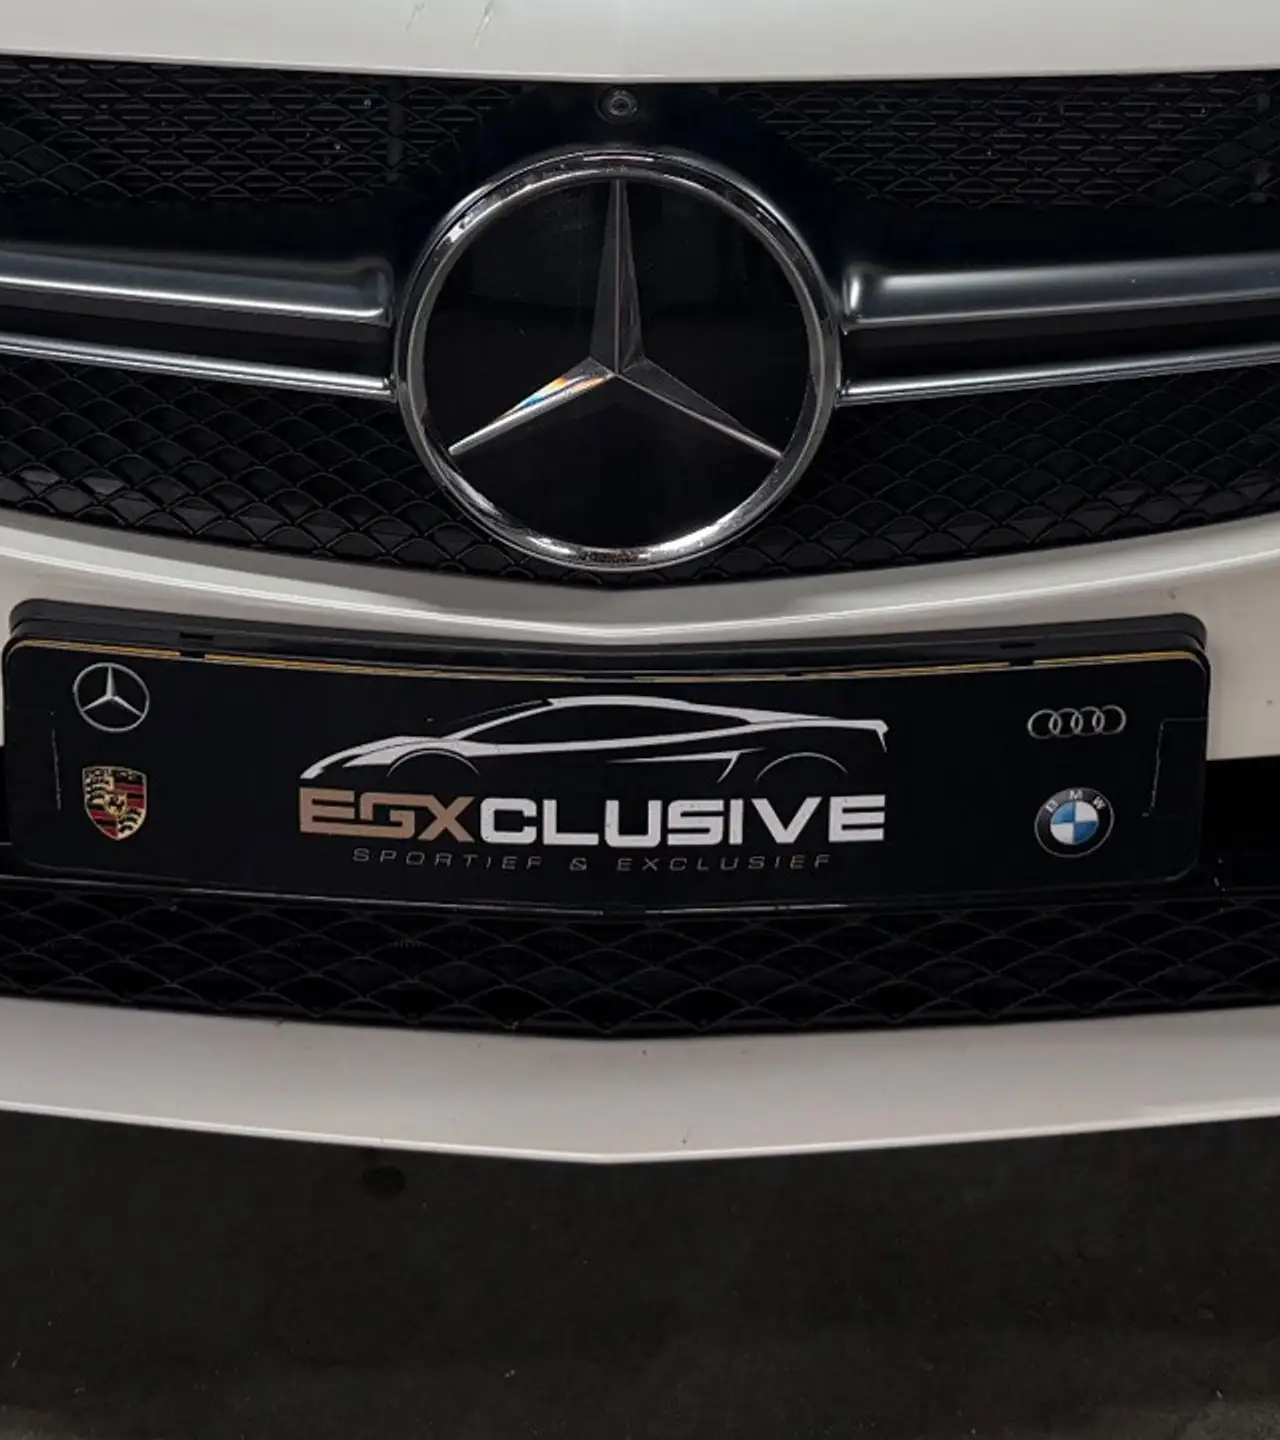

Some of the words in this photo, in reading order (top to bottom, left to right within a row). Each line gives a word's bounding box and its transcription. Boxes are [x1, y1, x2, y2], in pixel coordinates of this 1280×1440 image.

[1045, 788, 1108, 814] BMW
[298, 786, 886, 849] EGXCLUSIVE
[352, 847, 543, 871] SPORTIEF
[568, 856, 588, 872] &
[615, 853, 831, 872] EXCLUSIEF
